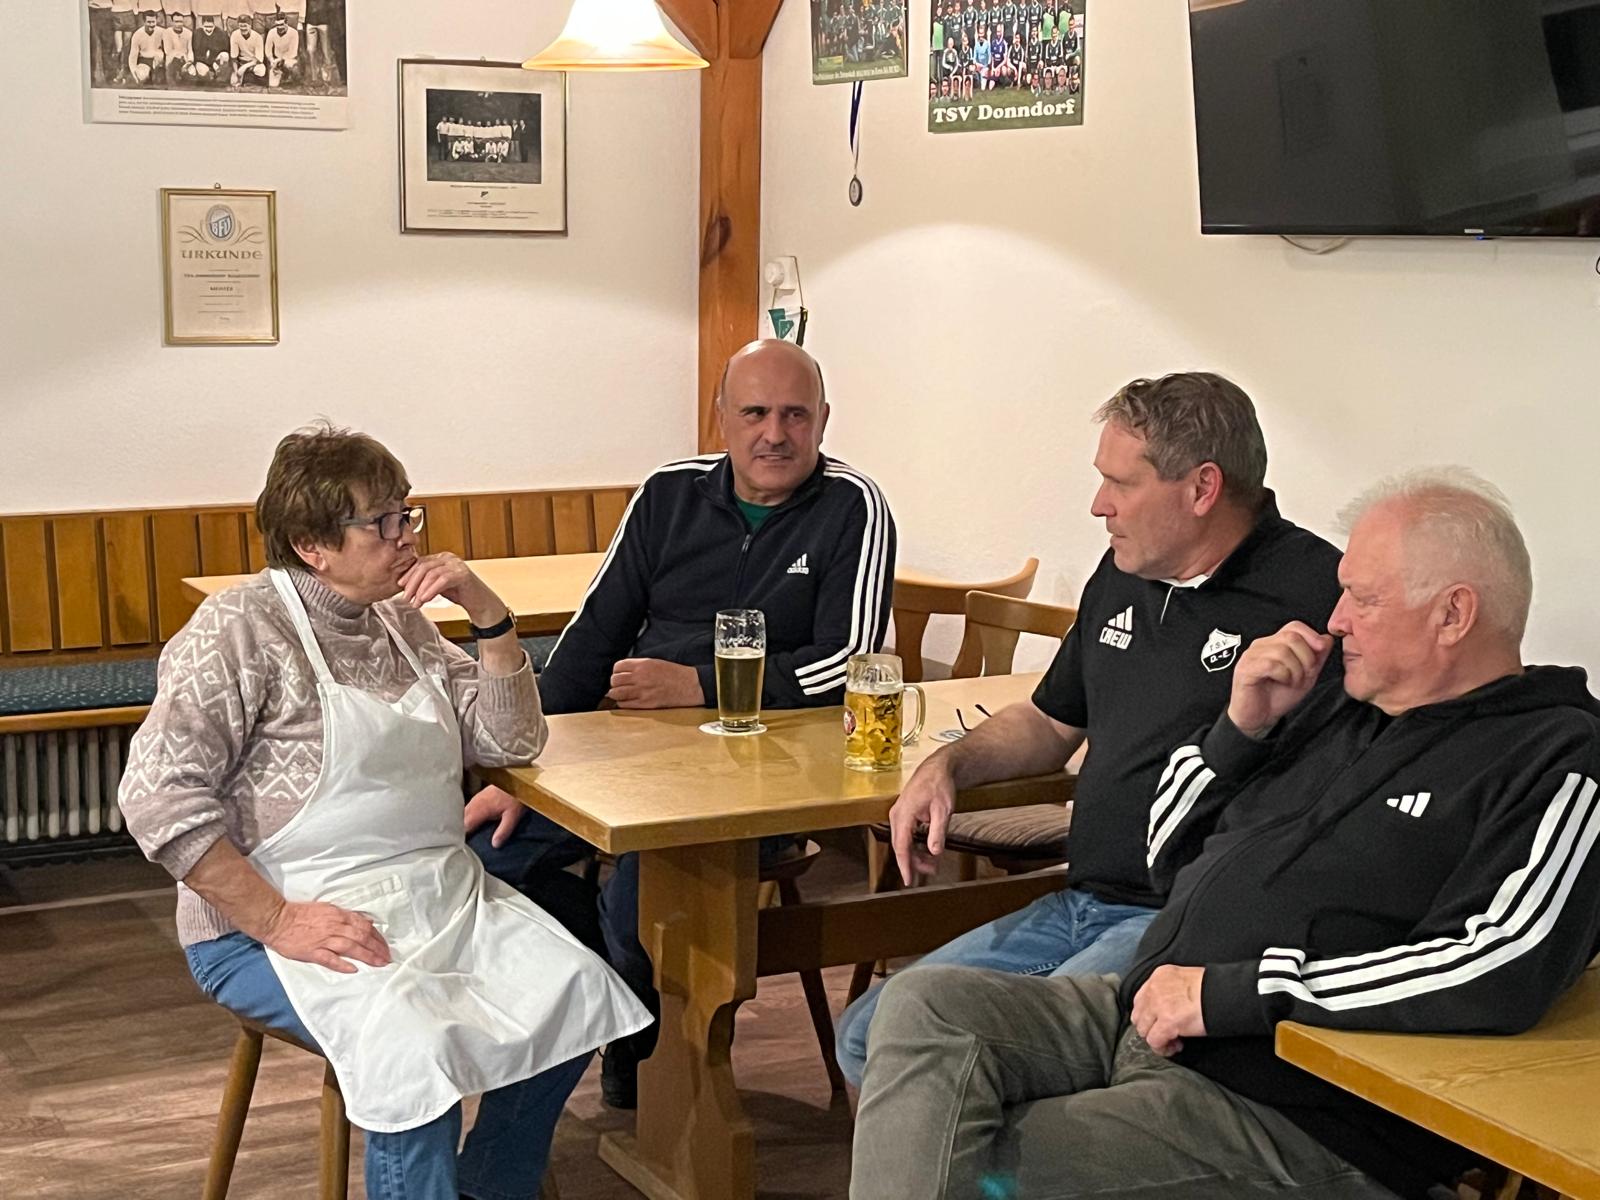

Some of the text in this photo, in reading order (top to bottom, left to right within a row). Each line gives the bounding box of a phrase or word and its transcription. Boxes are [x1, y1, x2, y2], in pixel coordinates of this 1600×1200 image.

[933, 98, 1076, 123] TSV Donndorf
[181, 249, 263, 260] URKUNDE
[1099, 626, 1133, 650] CREW
